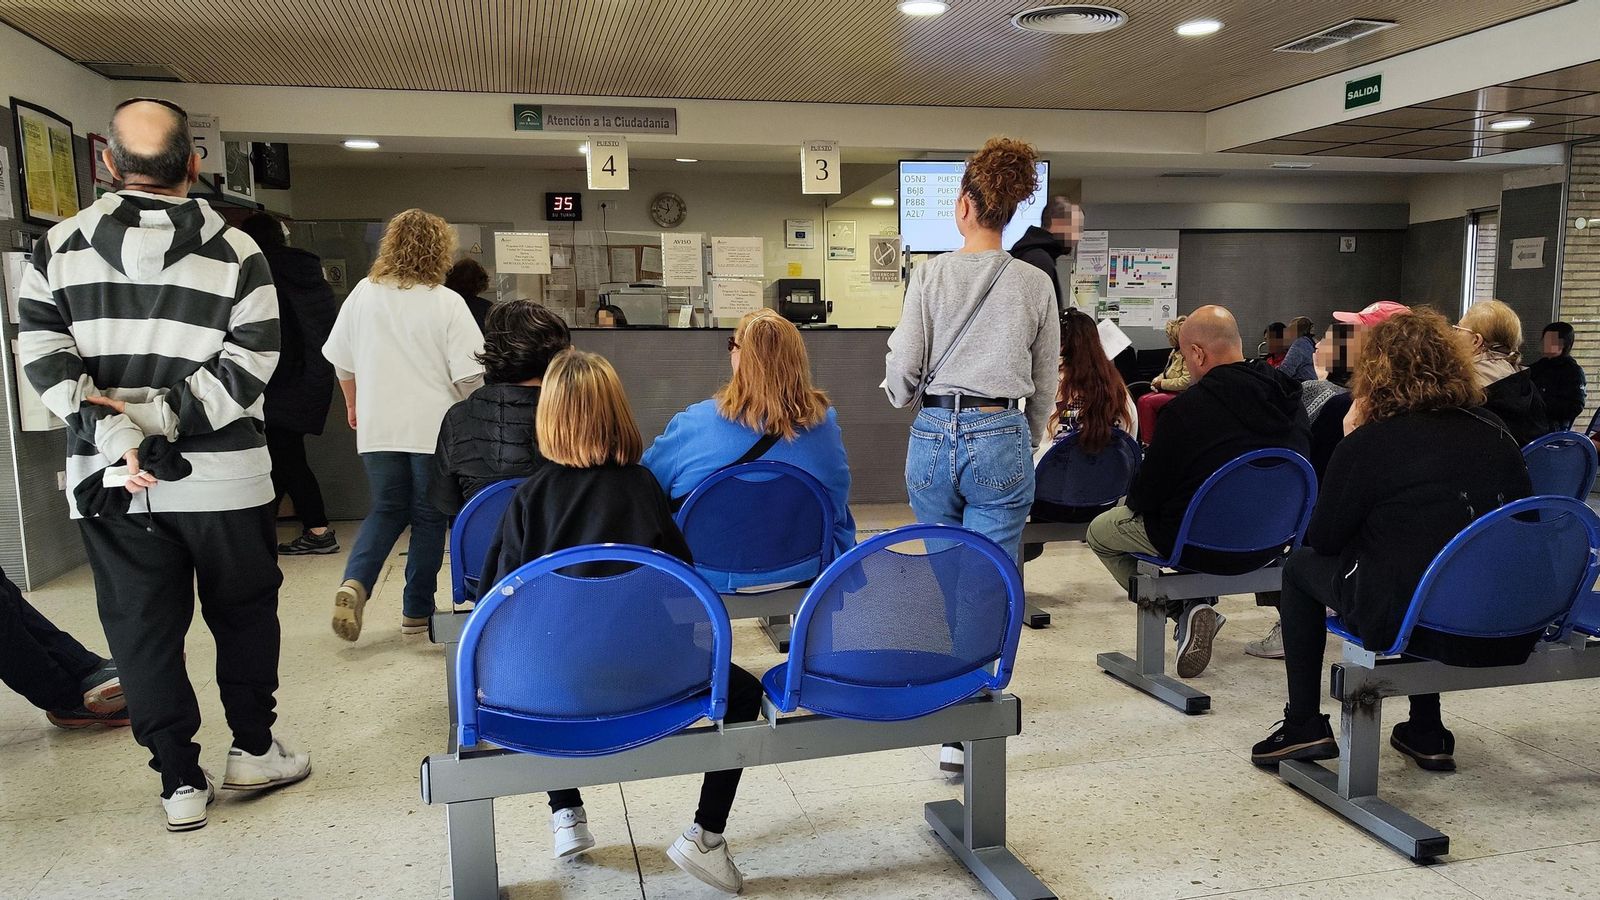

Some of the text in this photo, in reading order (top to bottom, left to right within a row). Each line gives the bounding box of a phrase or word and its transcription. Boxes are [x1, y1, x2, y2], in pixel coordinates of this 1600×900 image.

[1347, 84, 1379, 99] SALIDA
[189, 120, 211, 129] UESTO
[546, 114, 591, 127] Atención
[593, 118, 600, 127] a
[601, 115, 612, 127] la
[614, 116, 670, 129] Ciudadanía
[601, 154, 617, 177] 4
[815, 158, 829, 181] 3
[906, 186, 924, 196] B6J8
[553, 196, 573, 211] 35
[905, 198, 926, 206] P8B8
[905, 210, 925, 218] A2L7
